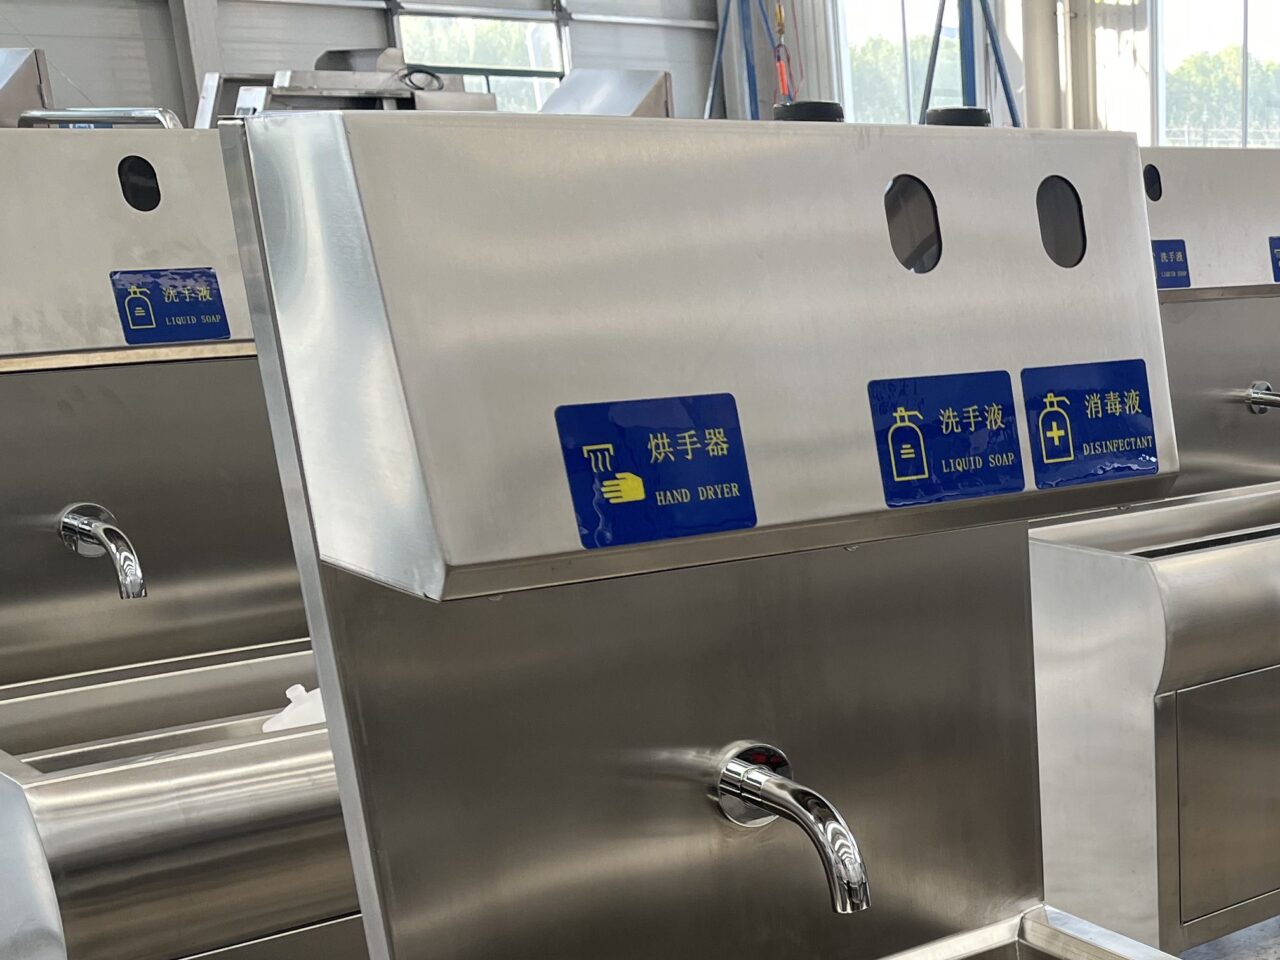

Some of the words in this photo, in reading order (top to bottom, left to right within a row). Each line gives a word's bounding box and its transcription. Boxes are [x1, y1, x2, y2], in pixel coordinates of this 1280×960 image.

[162, 286, 213, 303] 洗手液
[166, 316, 197, 326] LIQUID
[201, 315, 221, 324] SOAP
[1084, 389, 1143, 419] 消毒液
[938, 402, 1006, 435] 洗手液
[647, 427, 730, 464] 烘手器
[1083, 435, 1153, 456] DISINFECTANT
[942, 456, 983, 473] LIQUID
[989, 452, 1015, 467] SOAP
[655, 489, 691, 506] HAND
[698, 483, 740, 501] DRYER
